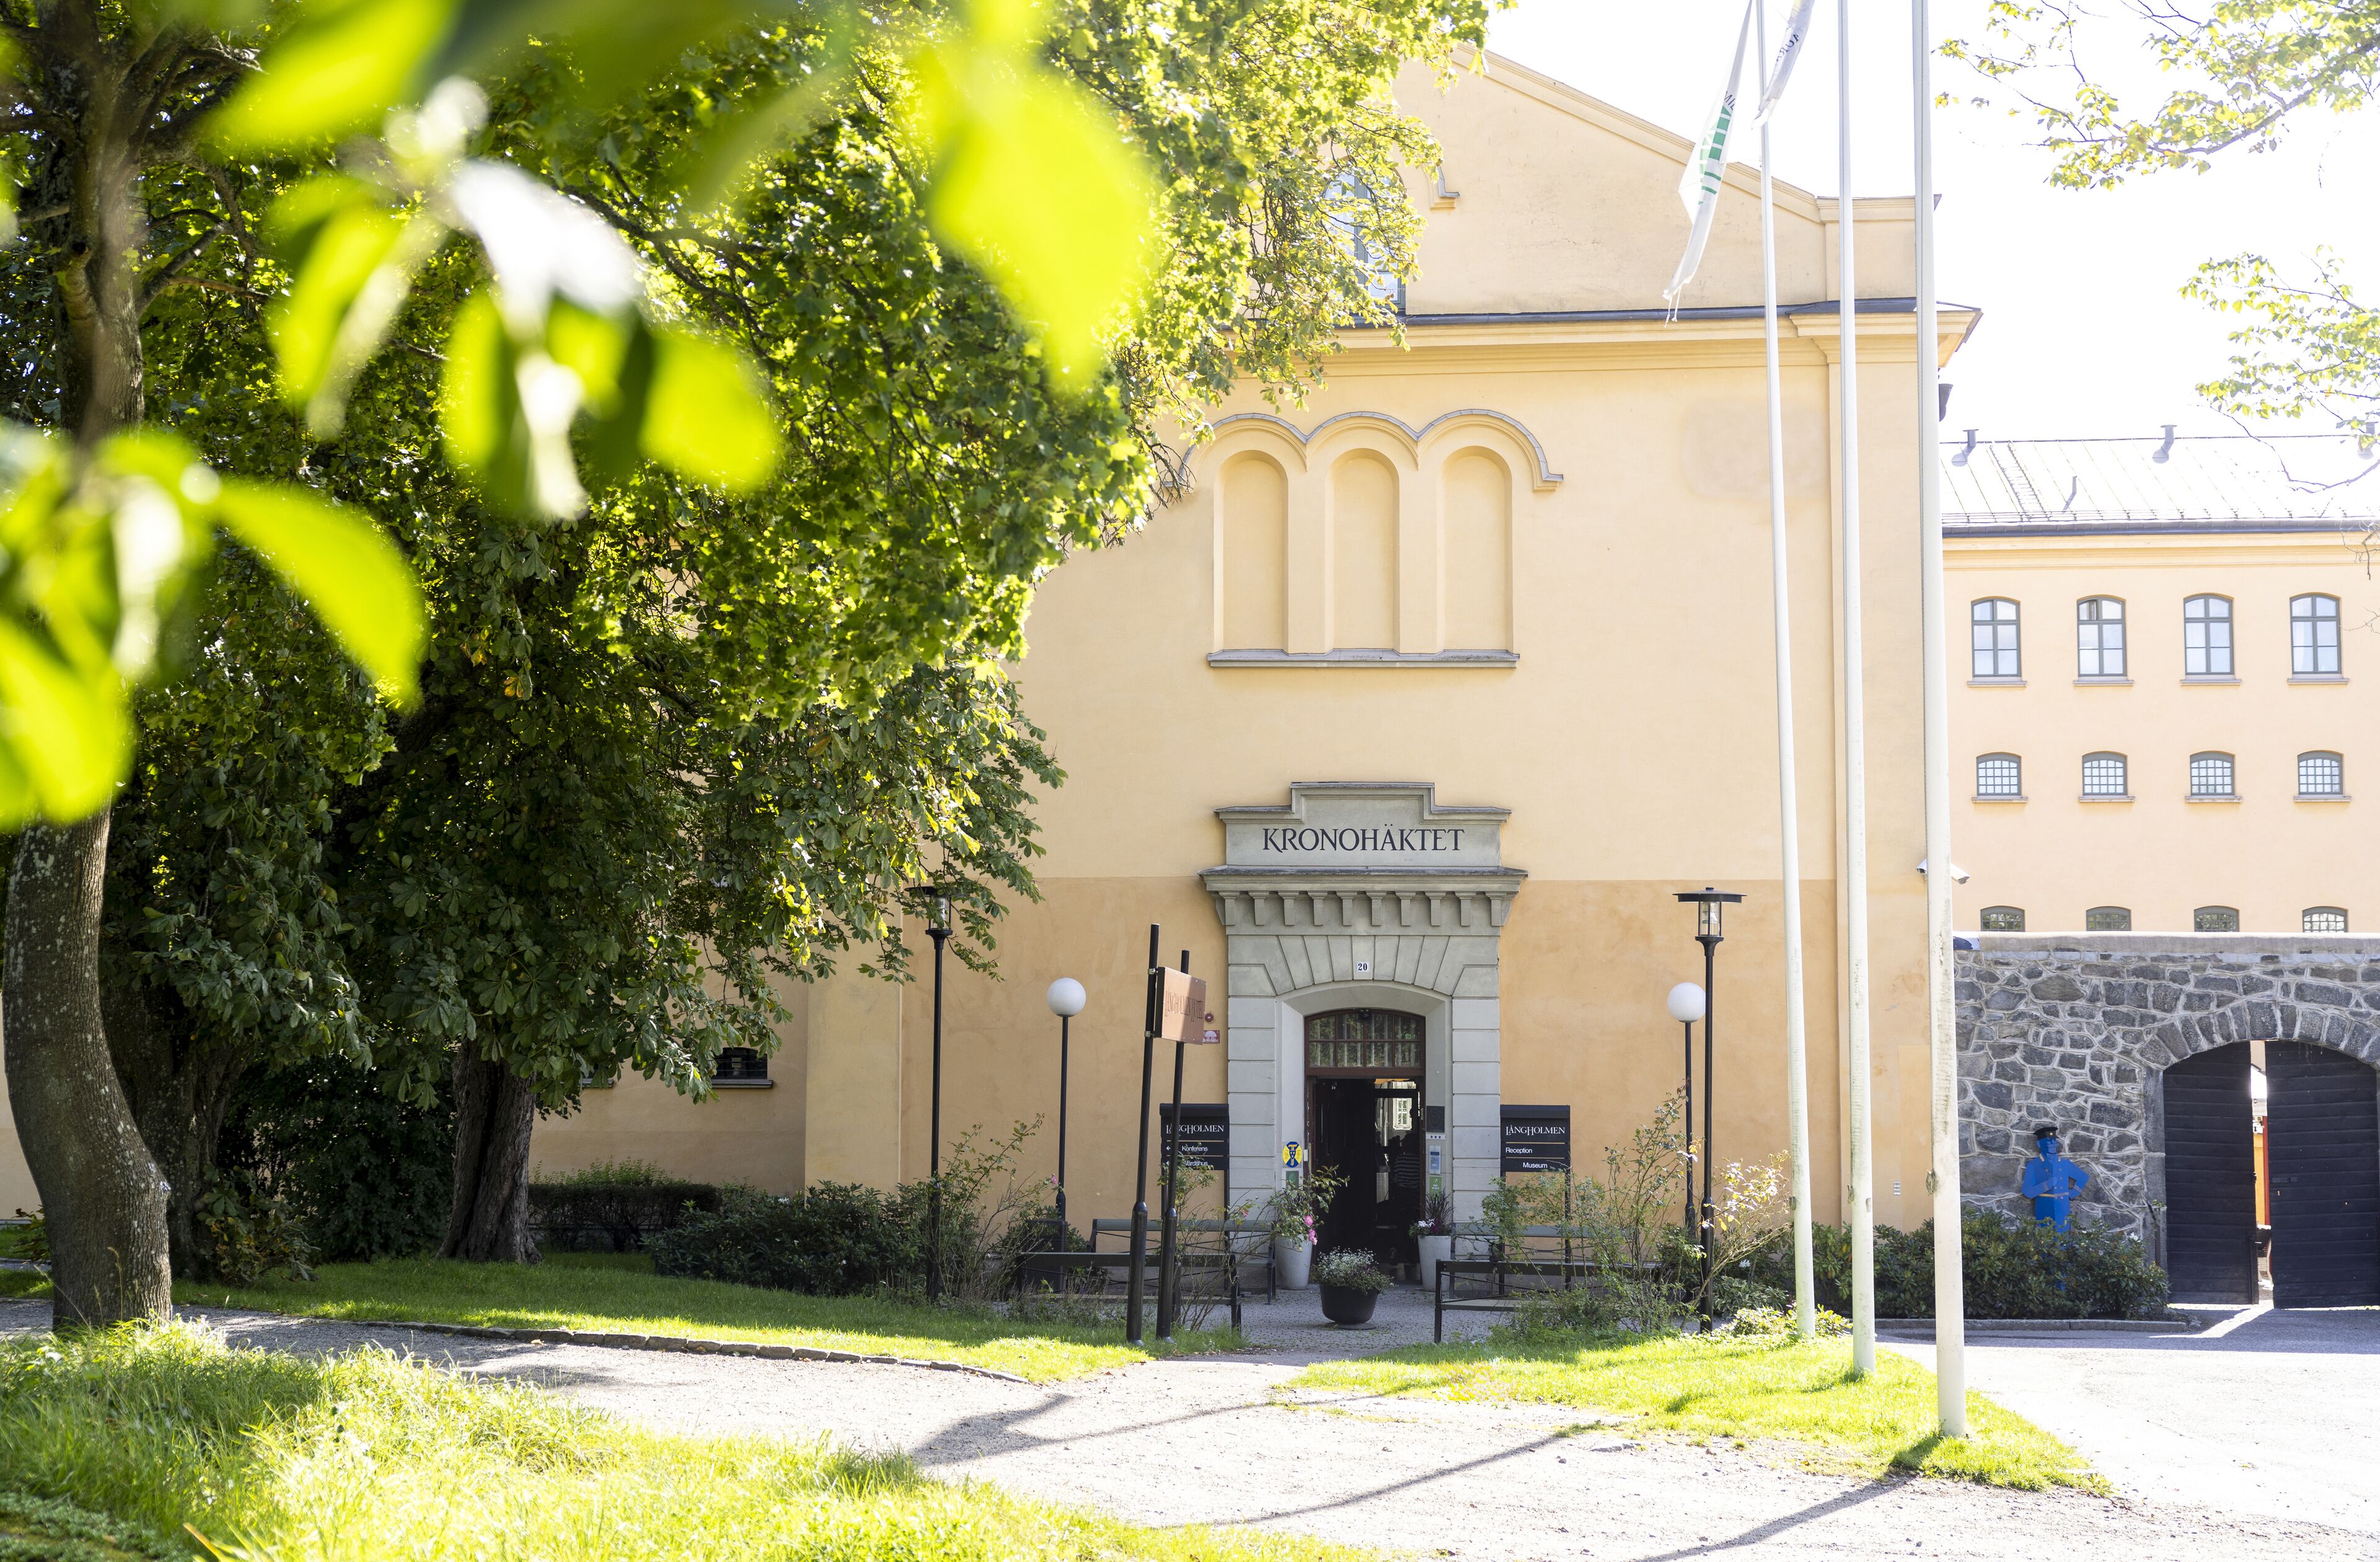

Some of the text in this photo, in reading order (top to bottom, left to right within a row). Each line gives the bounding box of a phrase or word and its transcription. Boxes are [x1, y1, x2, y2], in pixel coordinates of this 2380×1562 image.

[1263, 824, 1465, 853] KRONOHÄKTET
[1358, 963, 1367, 971] 20
[1505, 1124, 1565, 1136] LÅNGHOLMEN
